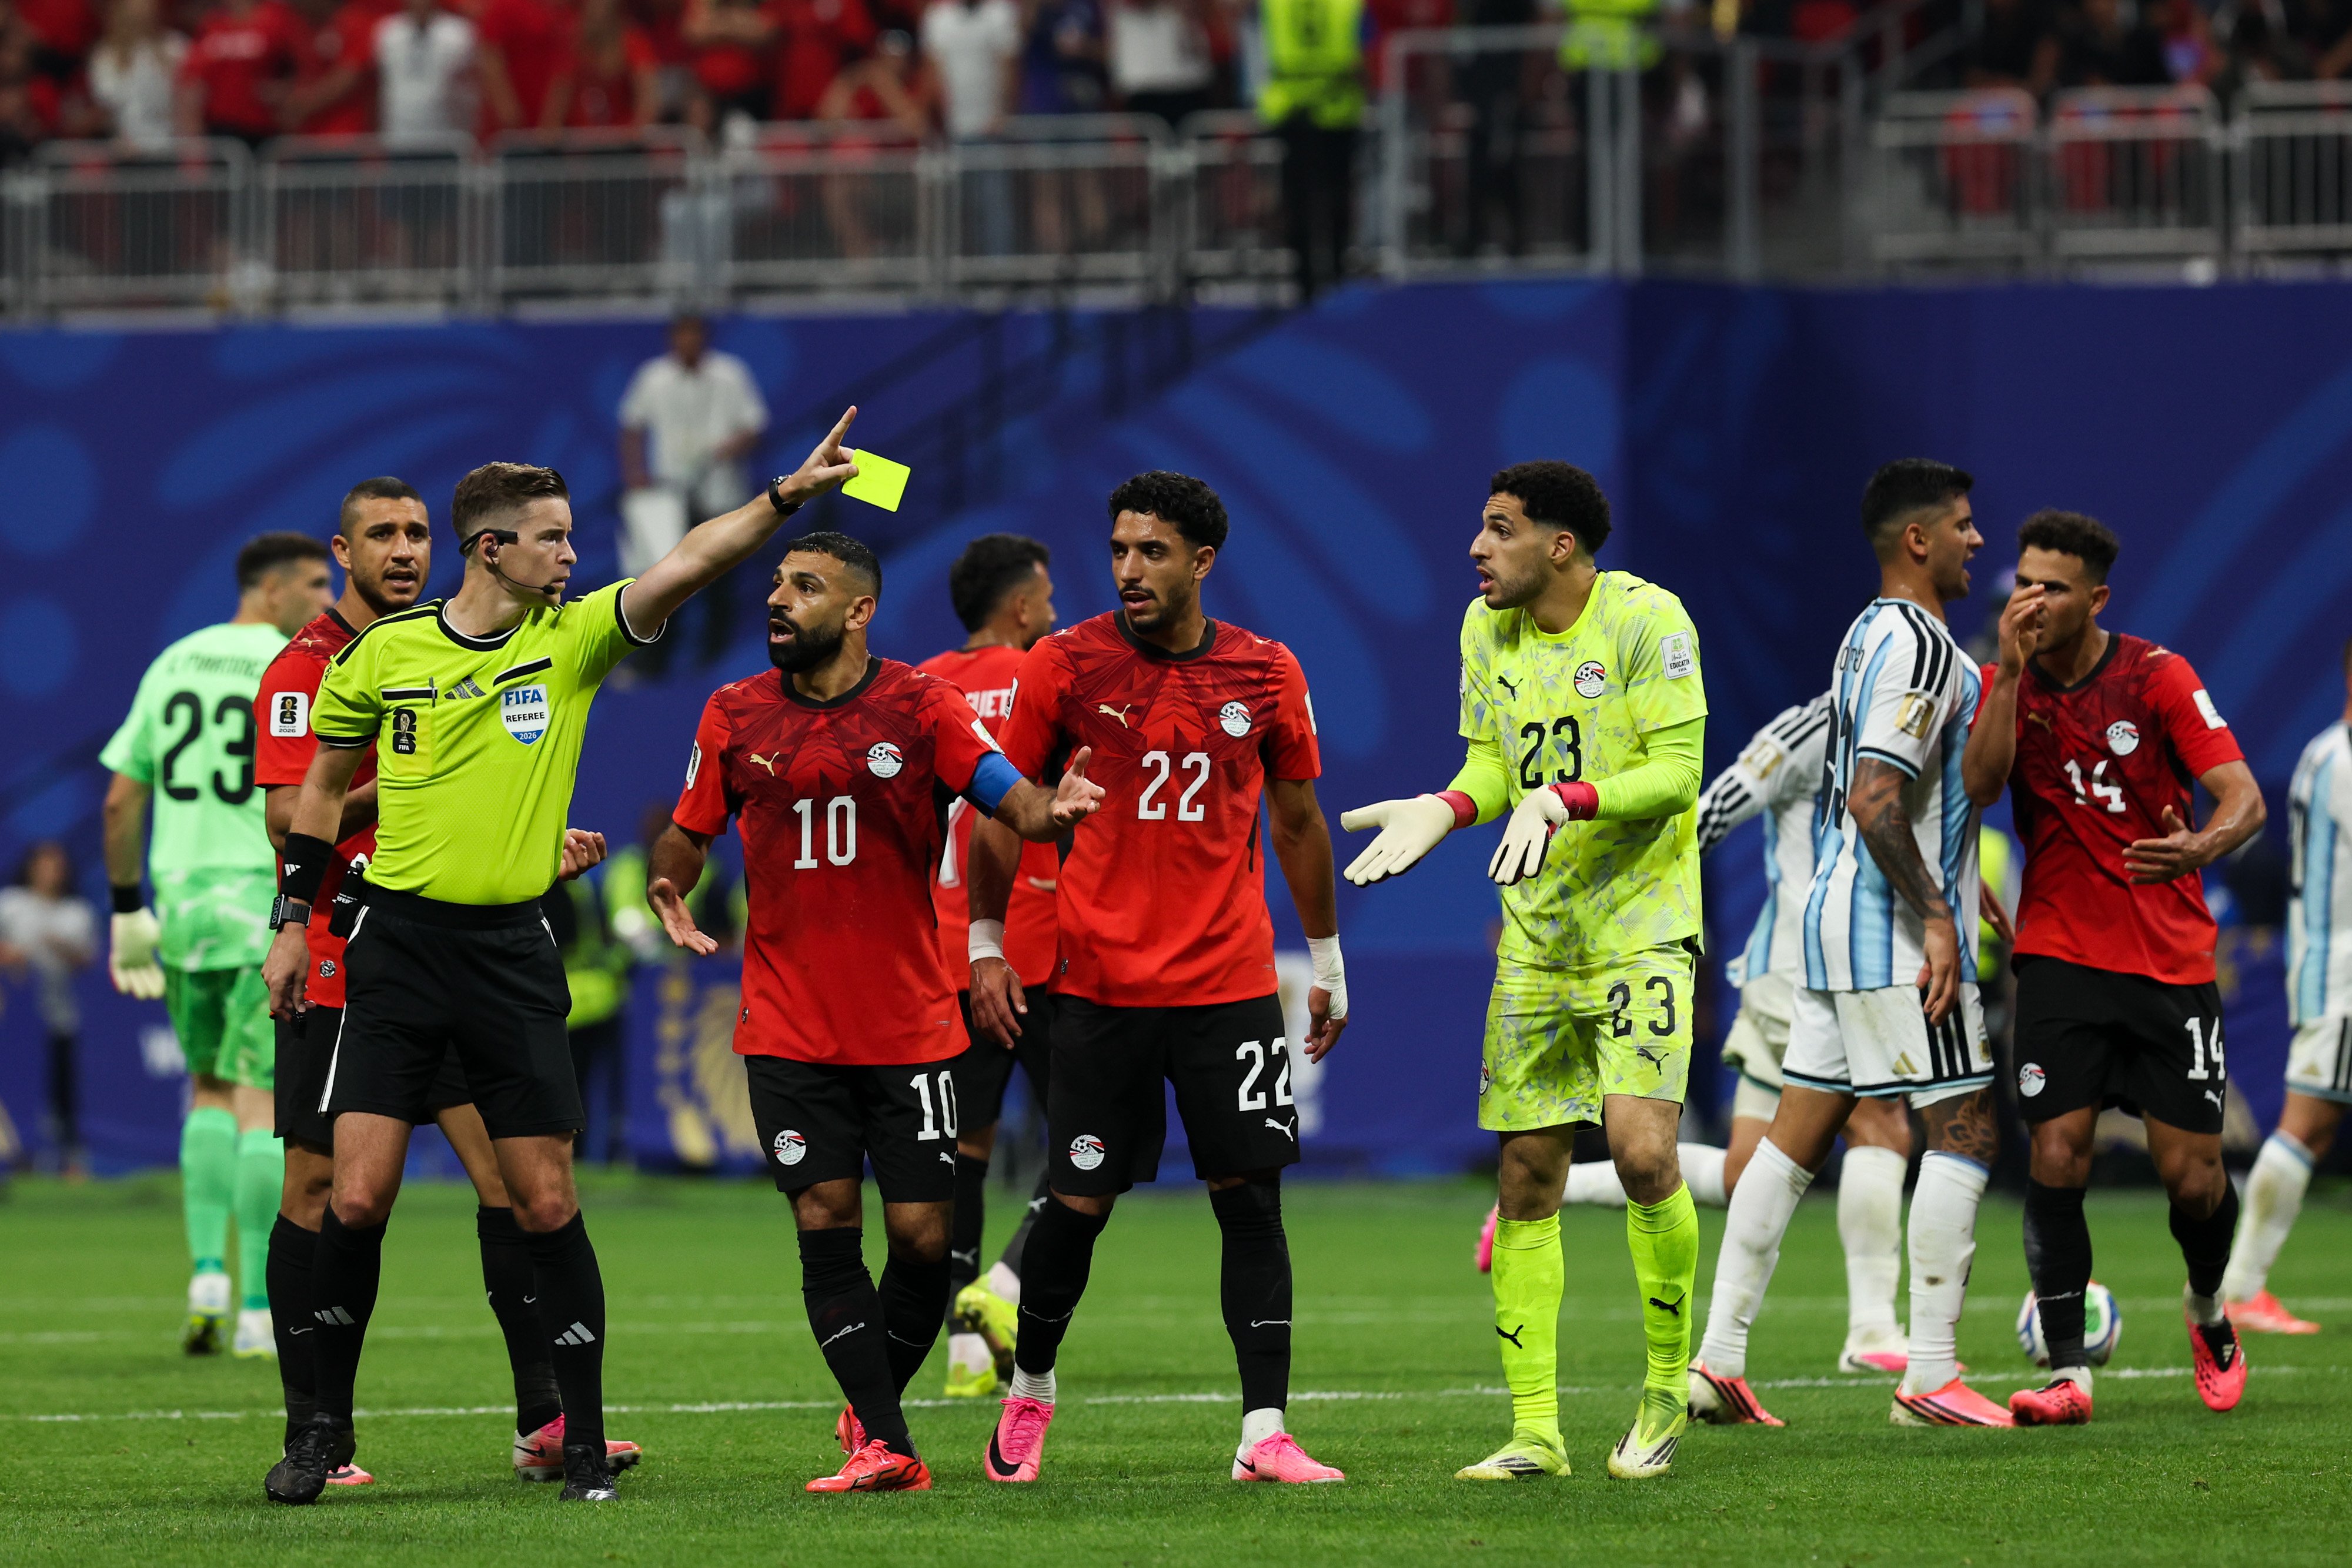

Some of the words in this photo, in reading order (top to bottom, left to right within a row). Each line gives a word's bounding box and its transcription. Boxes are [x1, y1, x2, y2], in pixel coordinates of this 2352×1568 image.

[505, 689, 543, 706] FIFA
[506, 712, 544, 723] REFEREE
[163, 690, 254, 804] 23
[1521, 716, 1581, 789] 23
[1138, 751, 1211, 821] 22
[2064, 759, 2126, 813] 14
[793, 795, 856, 870] 10
[1607, 976, 1675, 1038] 23
[1236, 1037, 1294, 1112] 22
[2184, 1016, 2226, 1081] 14
[910, 1071, 957, 1141] 10
